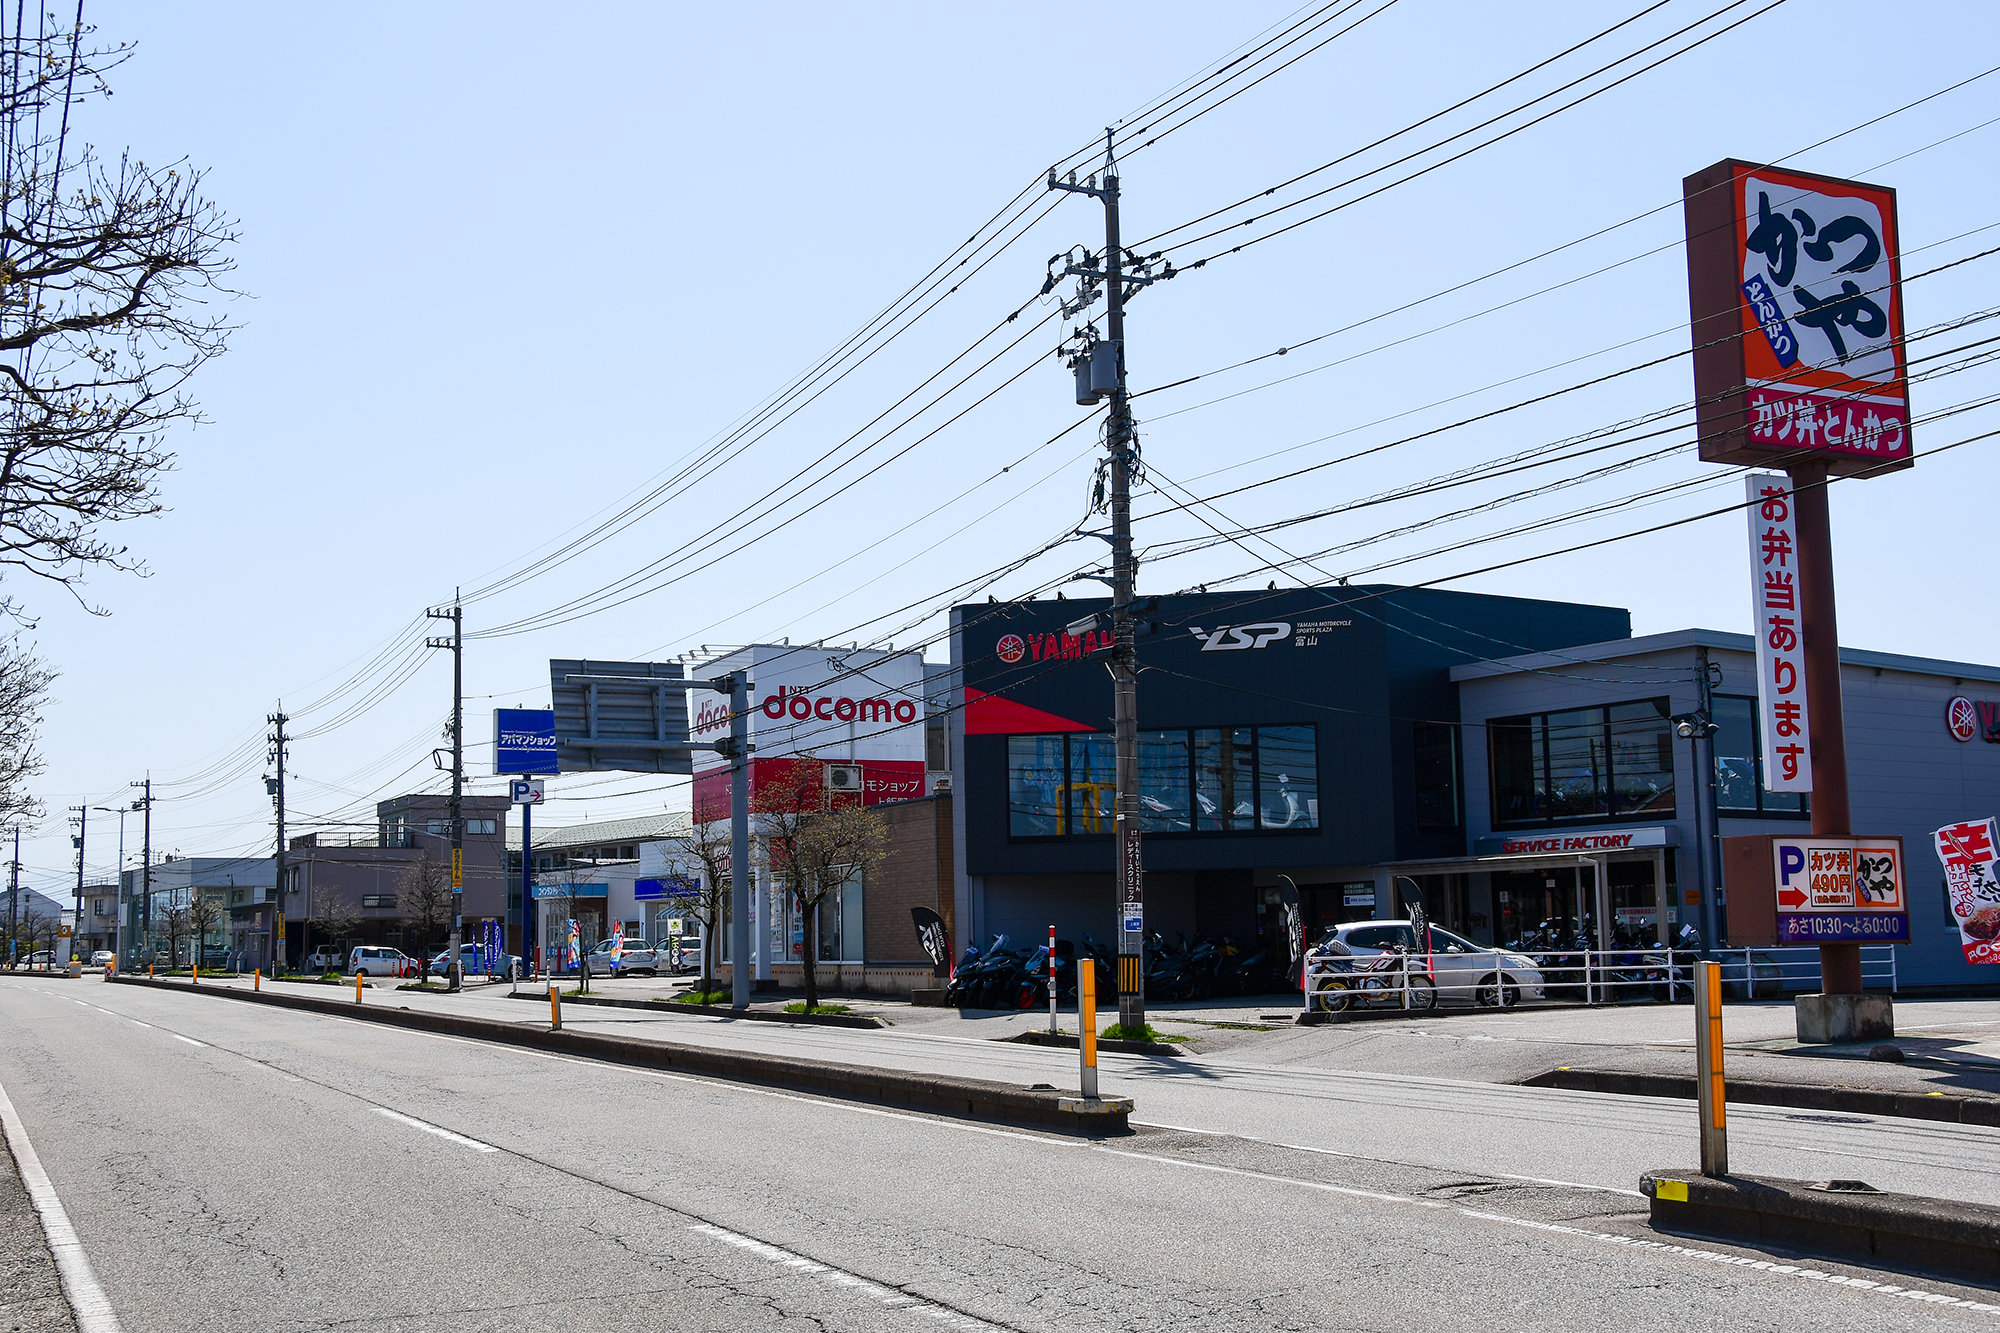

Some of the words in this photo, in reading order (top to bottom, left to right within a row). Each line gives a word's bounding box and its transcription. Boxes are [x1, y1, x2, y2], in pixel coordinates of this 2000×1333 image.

[1745, 282, 1791, 355] とんかつ
[1189, 622, 1292, 651] YSP
[1295, 635, 1318, 647] 富山
[1760, 486, 1804, 781] お弁当あります
[790, 686, 810, 694] NTT
[763, 685, 916, 723] docomo
[515, 782, 530, 801] P
[1502, 839, 1560, 854] SERVICE
[1563, 834, 1633, 850] FACTORY
[1780, 846, 1805, 885] P
[1811, 851, 1850, 871] カツ丼
[1812, 874, 1852, 893] 490円
